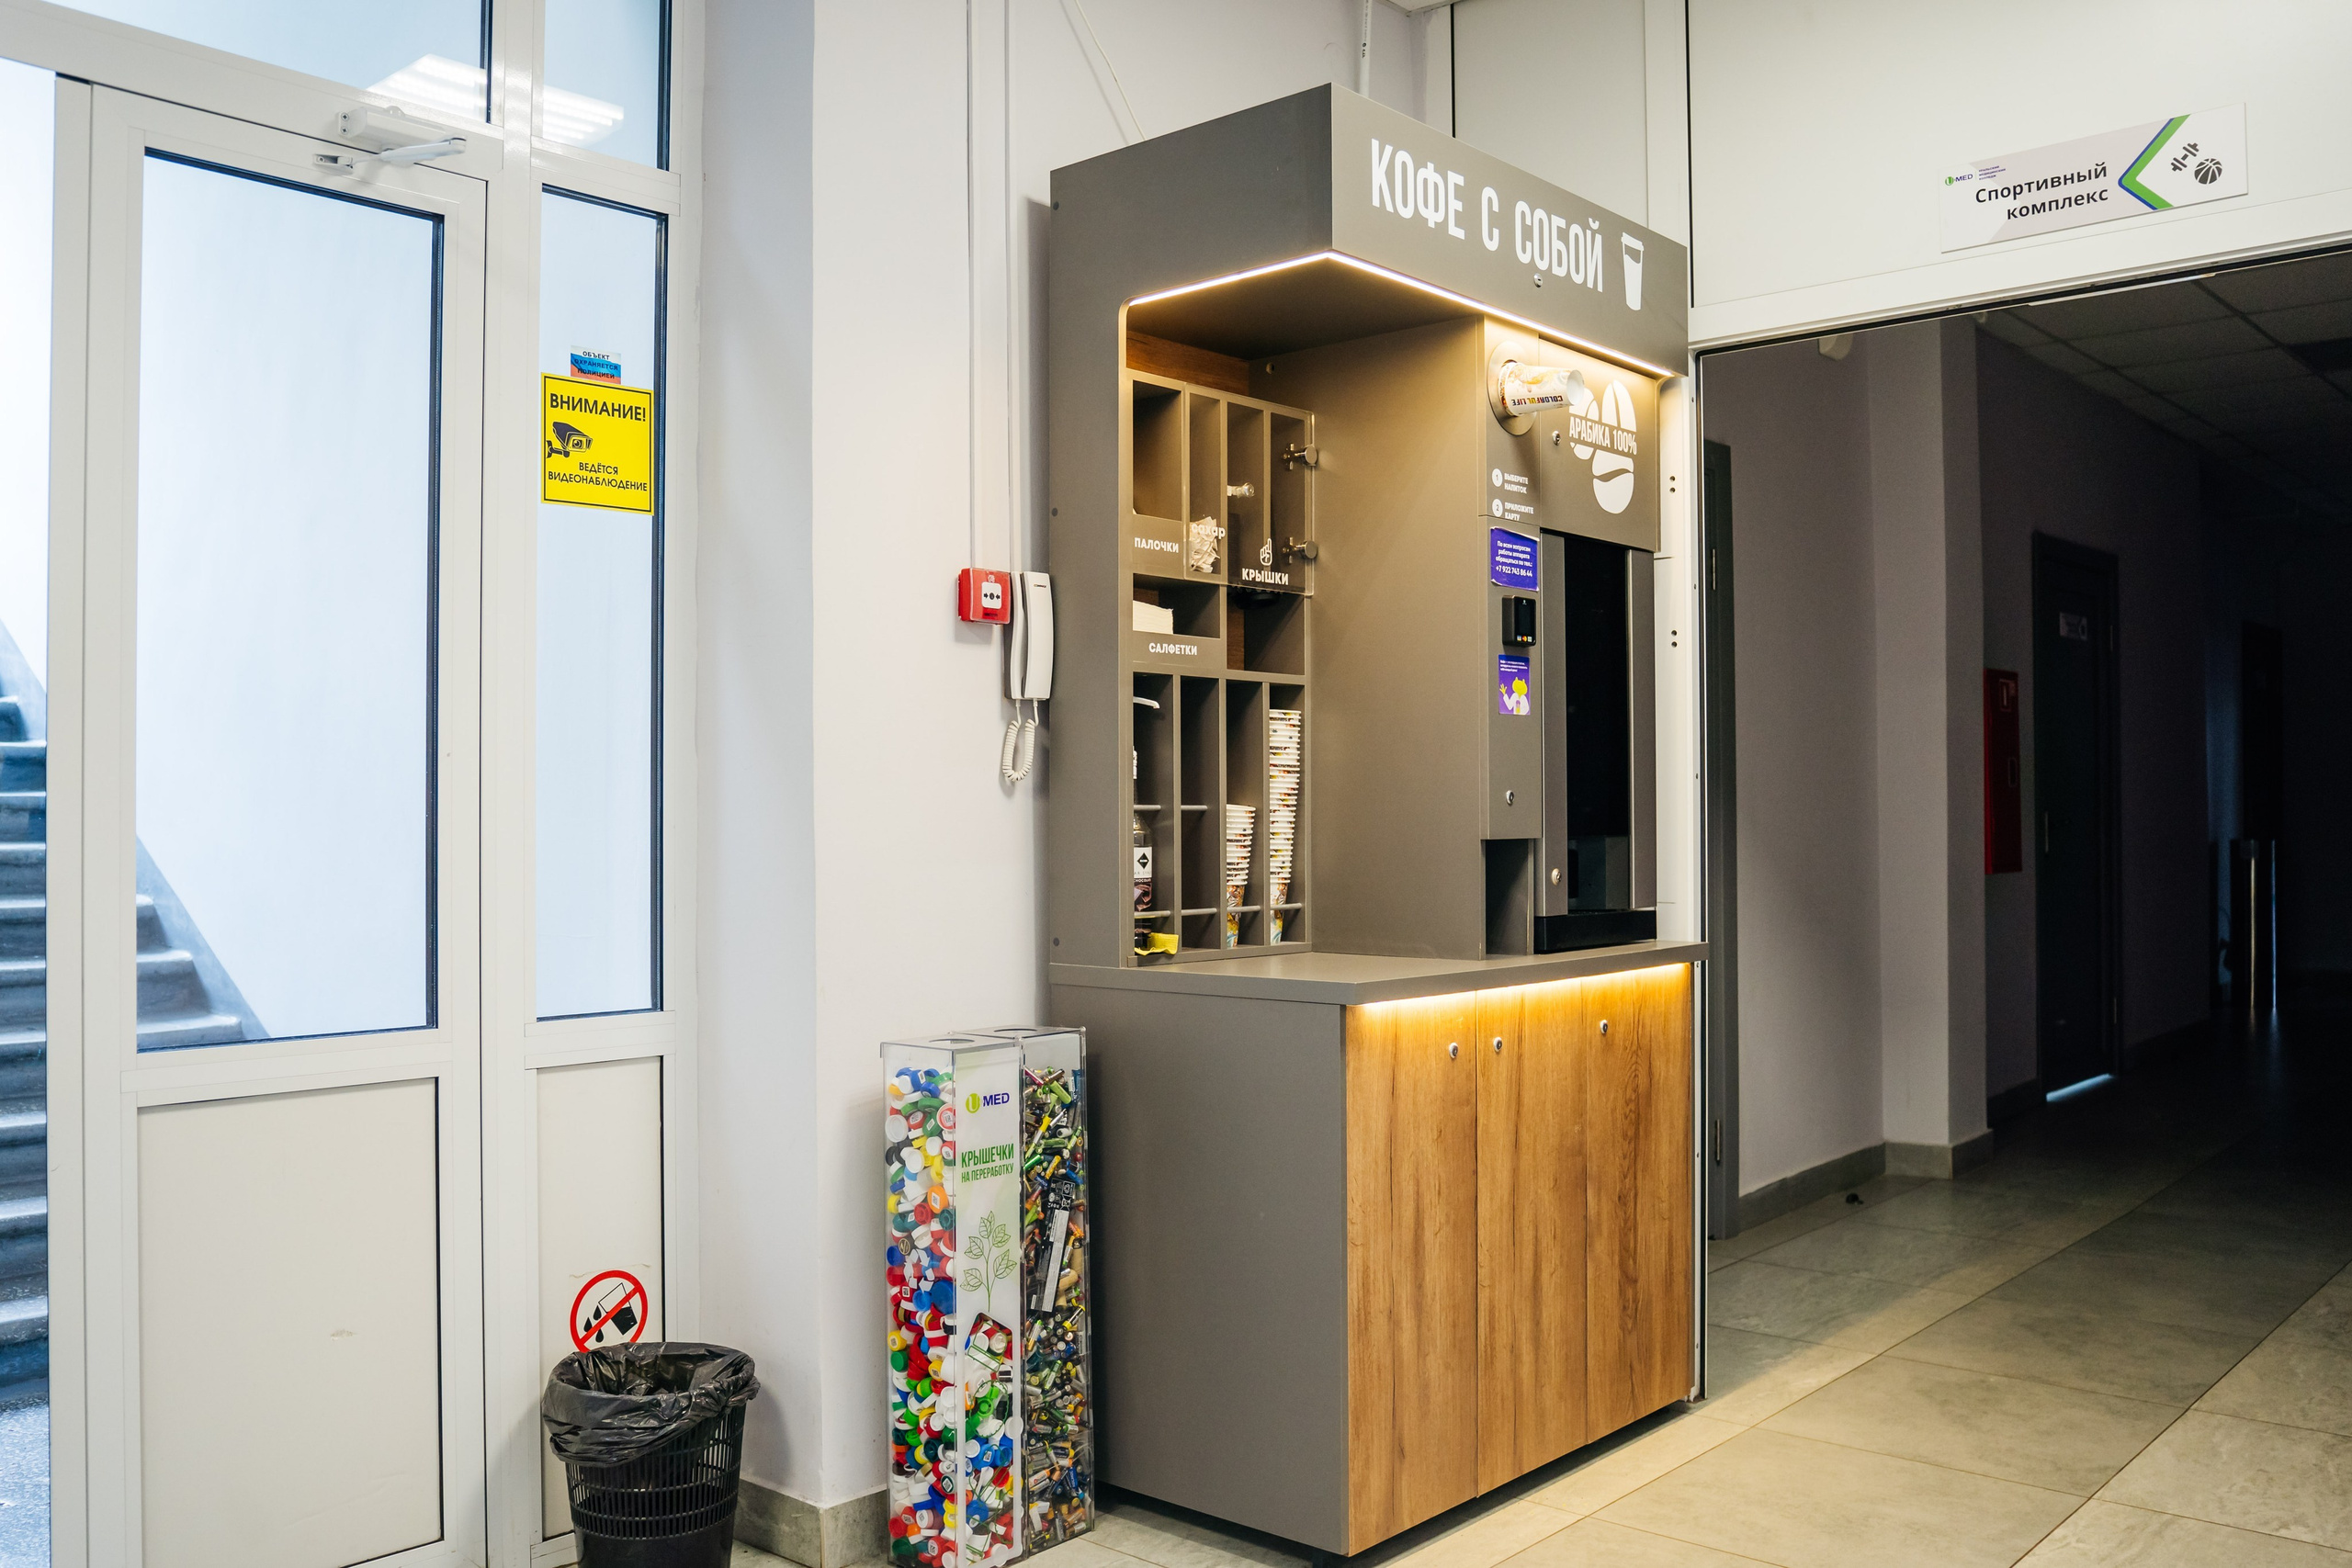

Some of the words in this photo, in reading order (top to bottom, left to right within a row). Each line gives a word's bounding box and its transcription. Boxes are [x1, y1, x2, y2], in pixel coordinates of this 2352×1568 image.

[1975, 162, 2108, 203] Спортивный
[2007, 187, 2109, 220] комплекс
[1371, 138, 1465, 241] КОФЕ
[1481, 186, 1499, 253] С
[1515, 199, 1603, 293] СОБОЙ
[582, 350, 610, 360] ОБЪЕКТ
[574, 358, 618, 371] ОХРАНЯЕТСЯ
[577, 367, 616, 379] ПОЛИЦИЕЙ
[550, 393, 646, 422] ВНИМАНИЕ!
[1511, 398, 1527, 406] LIFE
[1527, 395, 1564, 404] COLORFUL
[1568, 416, 1611, 448] АРАБИКА
[1612, 428, 1637, 456] 100%
[579, 461, 618, 476] ВЕДЁТСЯ
[548, 471, 647, 491] ВИДЕОНАБЛЮДЕНИЕ
[1504, 473, 1528, 484] ВЫБЕРИТЕ
[1504, 483, 1527, 493] НАПИТОК
[1504, 513, 1520, 521] КАРТУ
[1192, 523, 1226, 540] сахар
[1134, 537, 1180, 553] ПАЛОЧКИ
[1241, 568, 1289, 585] КРЫШКИ
[1148, 642, 1197, 656] САЛФЕТКИ
[961, 1143, 1014, 1168] КРЫШЕЧКИ
[961, 1171, 970, 1183] НА
[971, 1162, 1014, 1181] ПЕРЕРАБОТКУ
